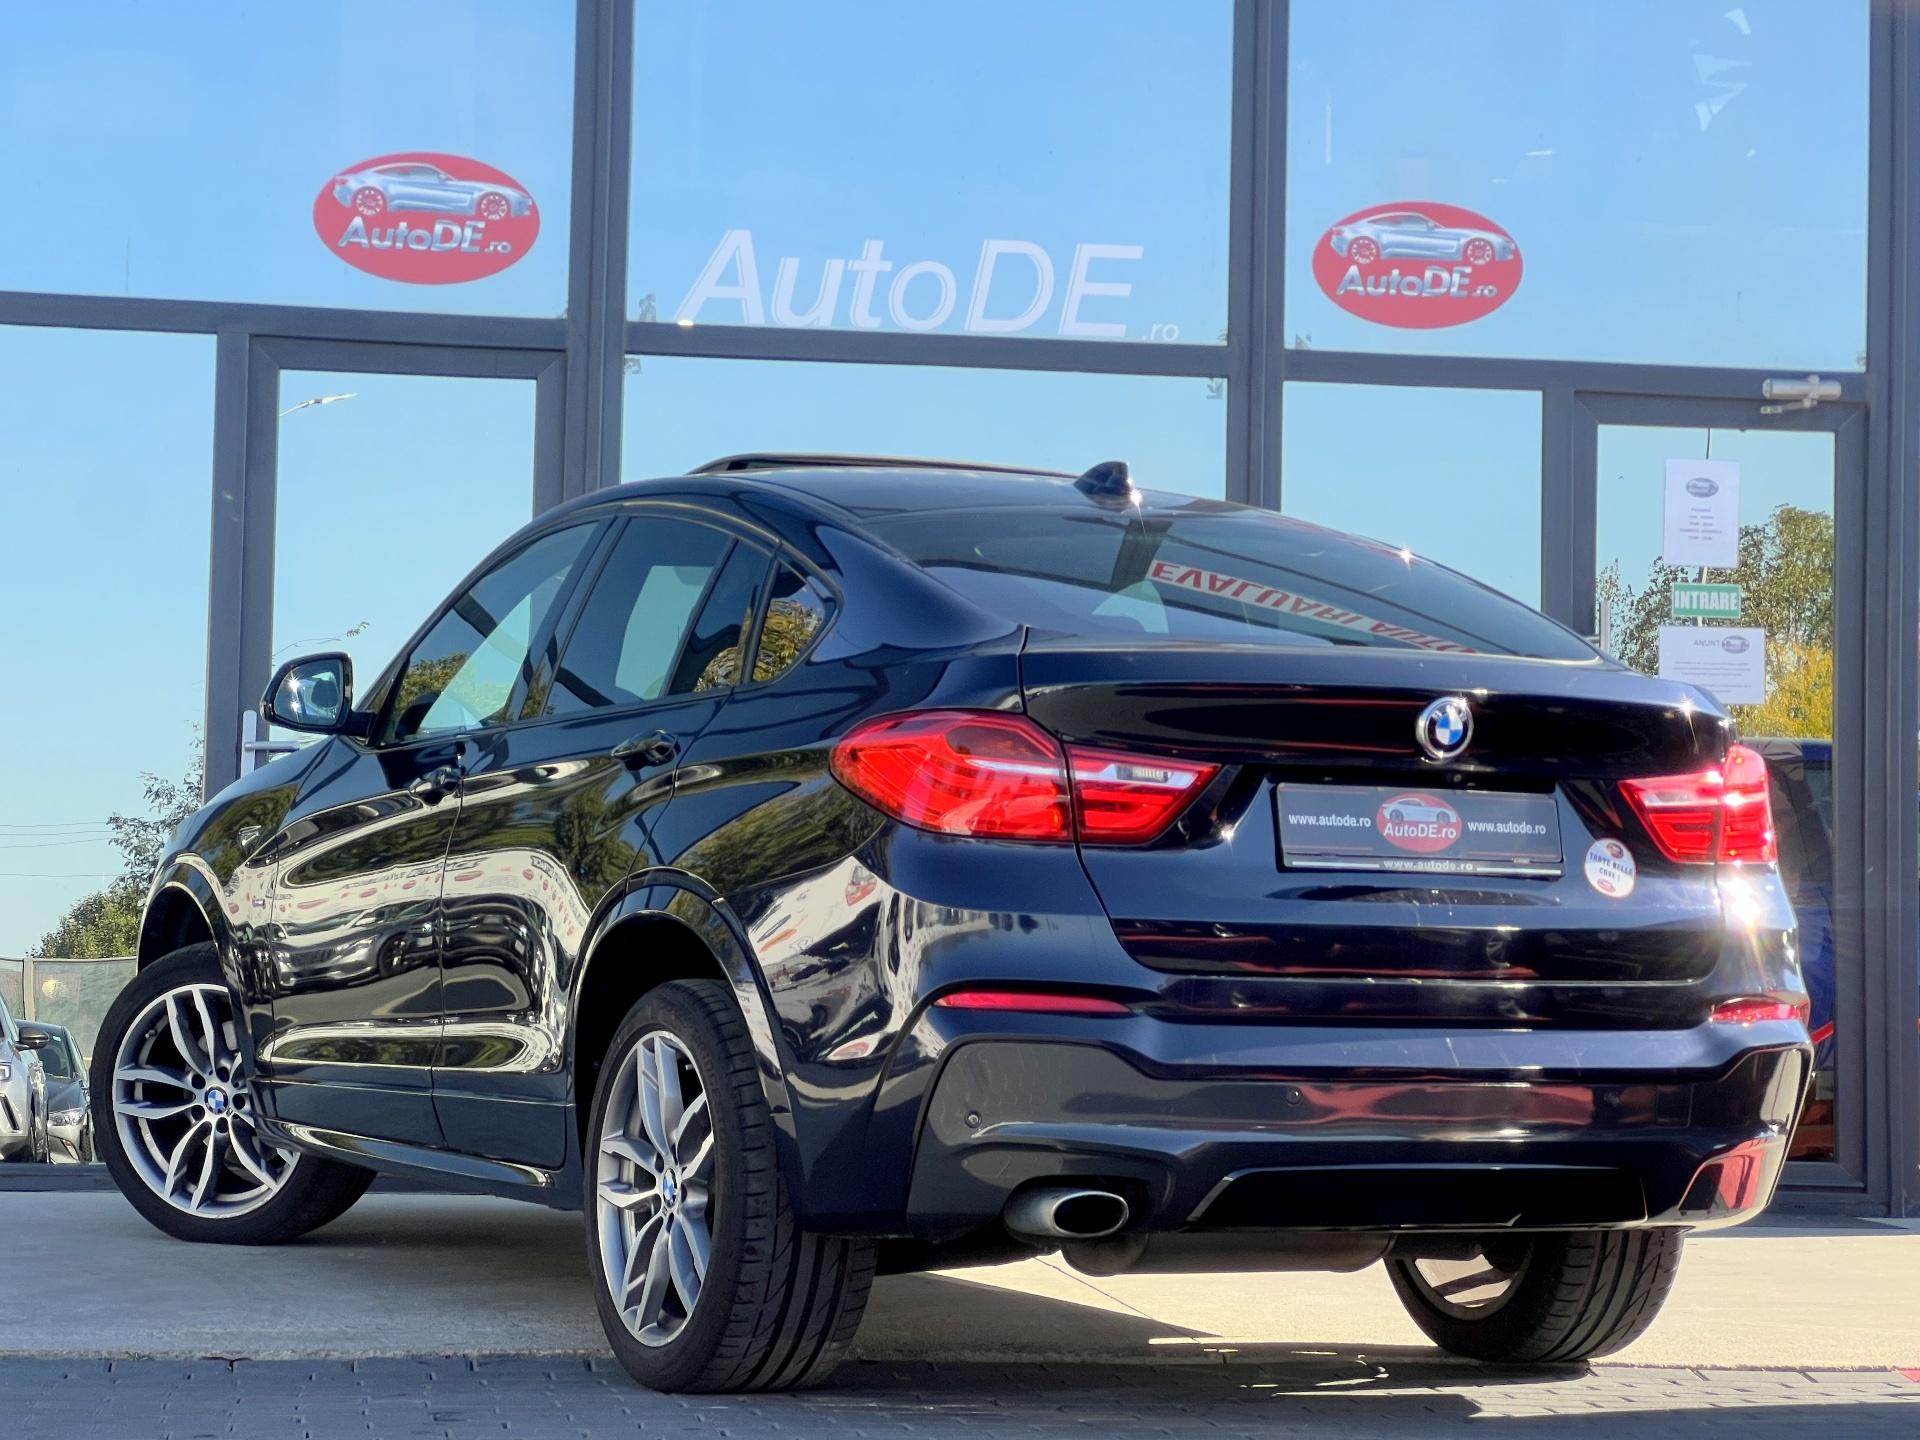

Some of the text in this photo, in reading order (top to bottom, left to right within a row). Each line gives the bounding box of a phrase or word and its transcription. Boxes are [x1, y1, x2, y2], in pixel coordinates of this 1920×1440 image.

[1674, 590, 1738, 610] INTRARE
[1288, 813, 1546, 839] www.autode.ro AutoDE.ro www.autode.ro
[1383, 859, 1473, 872] www.autode.ro
